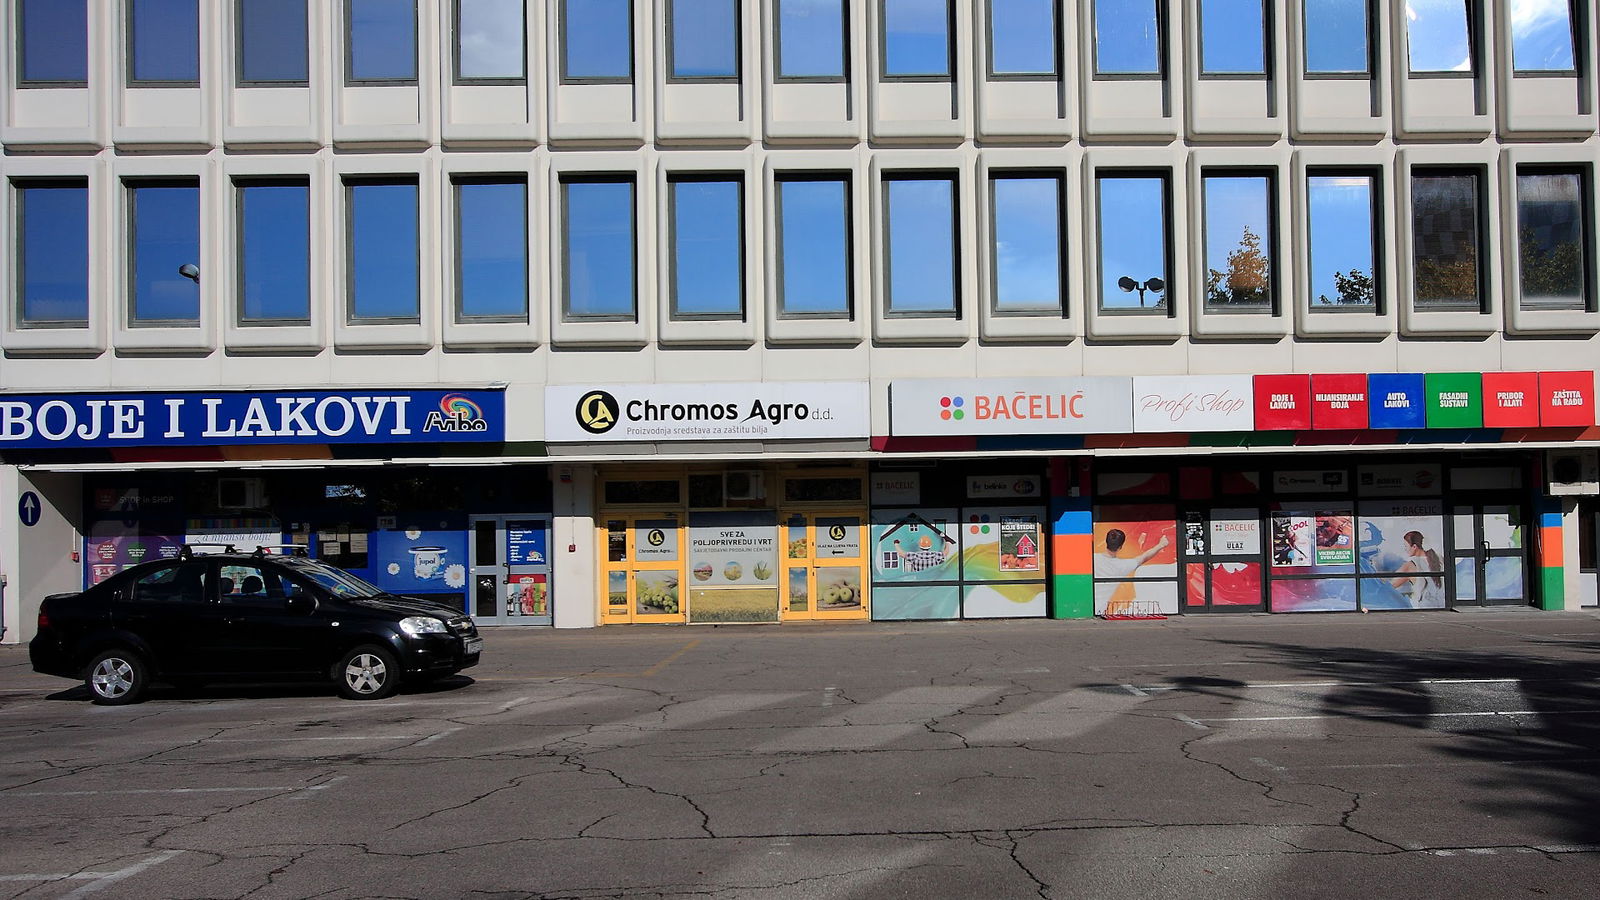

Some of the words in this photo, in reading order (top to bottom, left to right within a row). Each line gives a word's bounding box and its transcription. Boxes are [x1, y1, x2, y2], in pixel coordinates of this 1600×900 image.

[1497, 392, 1524, 400] PRIBOR
[1552, 390, 1581, 398] ZAŠTITA
[1139, 393, 1197, 421] Profi
[1196, 389, 1244, 416] Shop
[1331, 401, 1349, 409] BOJA
[1384, 400, 1409, 408] LAKOVI
[1503, 399, 1522, 407] ALATI
[1551, 398, 1562, 406] NA
[1563, 397, 1583, 405] RADU
[626, 400, 738, 421] Chromos
[740, 399, 809, 425] Agro
[811, 409, 834, 420] d.d.
[0, 399, 144, 440] BOJE
[163, 399, 185, 438] I
[202, 396, 411, 437] LAKOVI
[626, 427, 672, 435] Proizvodnja
[673, 426, 711, 434] sredstava
[723, 426, 750, 434] zaštitu
[752, 426, 768, 435] bilja
